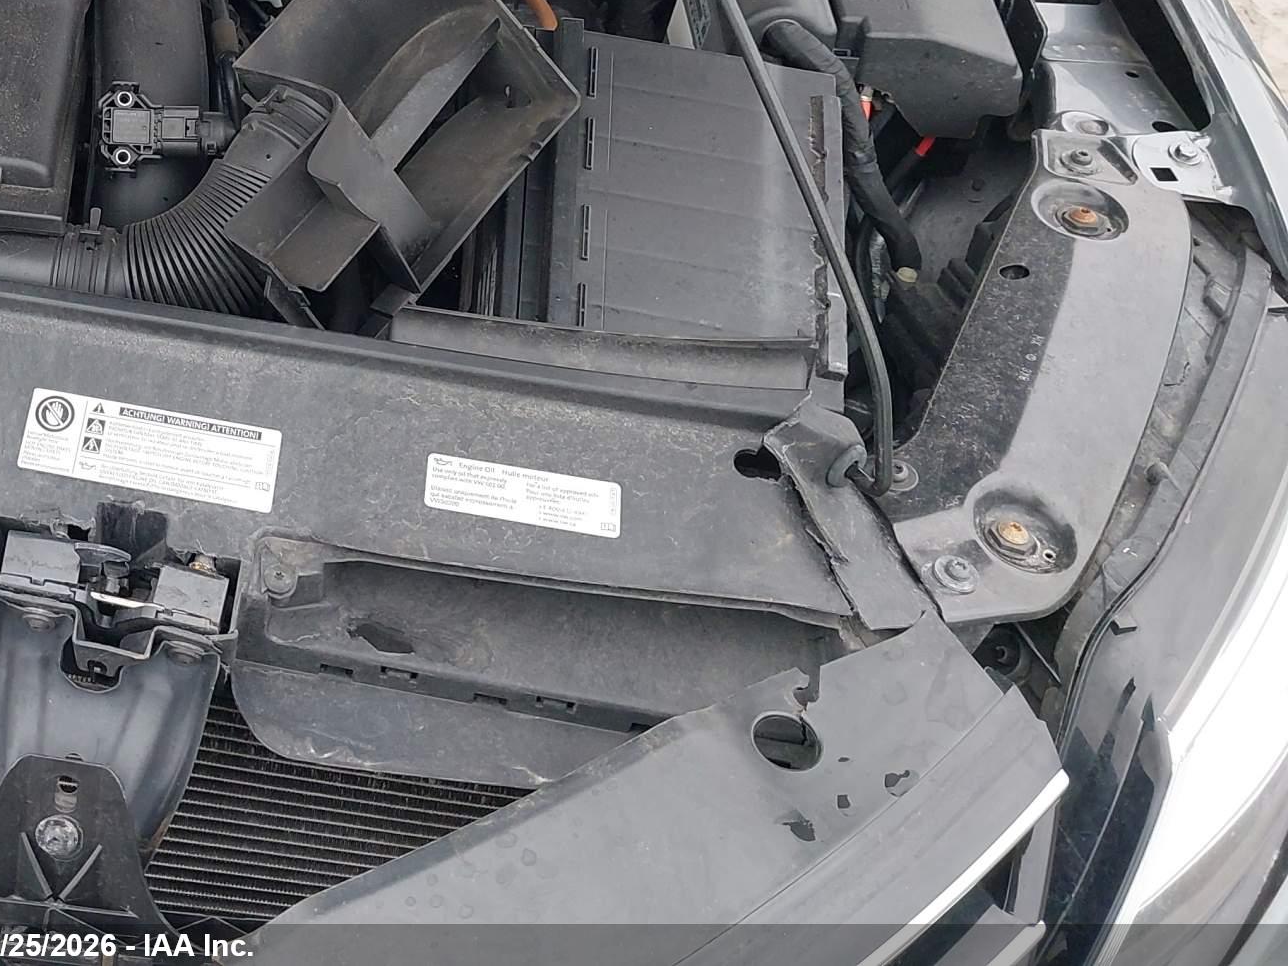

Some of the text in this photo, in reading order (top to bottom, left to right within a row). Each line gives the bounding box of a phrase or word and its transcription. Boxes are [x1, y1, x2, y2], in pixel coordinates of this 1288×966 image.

[122, 408, 166, 422] ACHTUNG!
[167, 416, 210, 431] WARNING!
[211, 423, 259, 440] ATTENTION!
[459, 462, 483, 472] Engine
